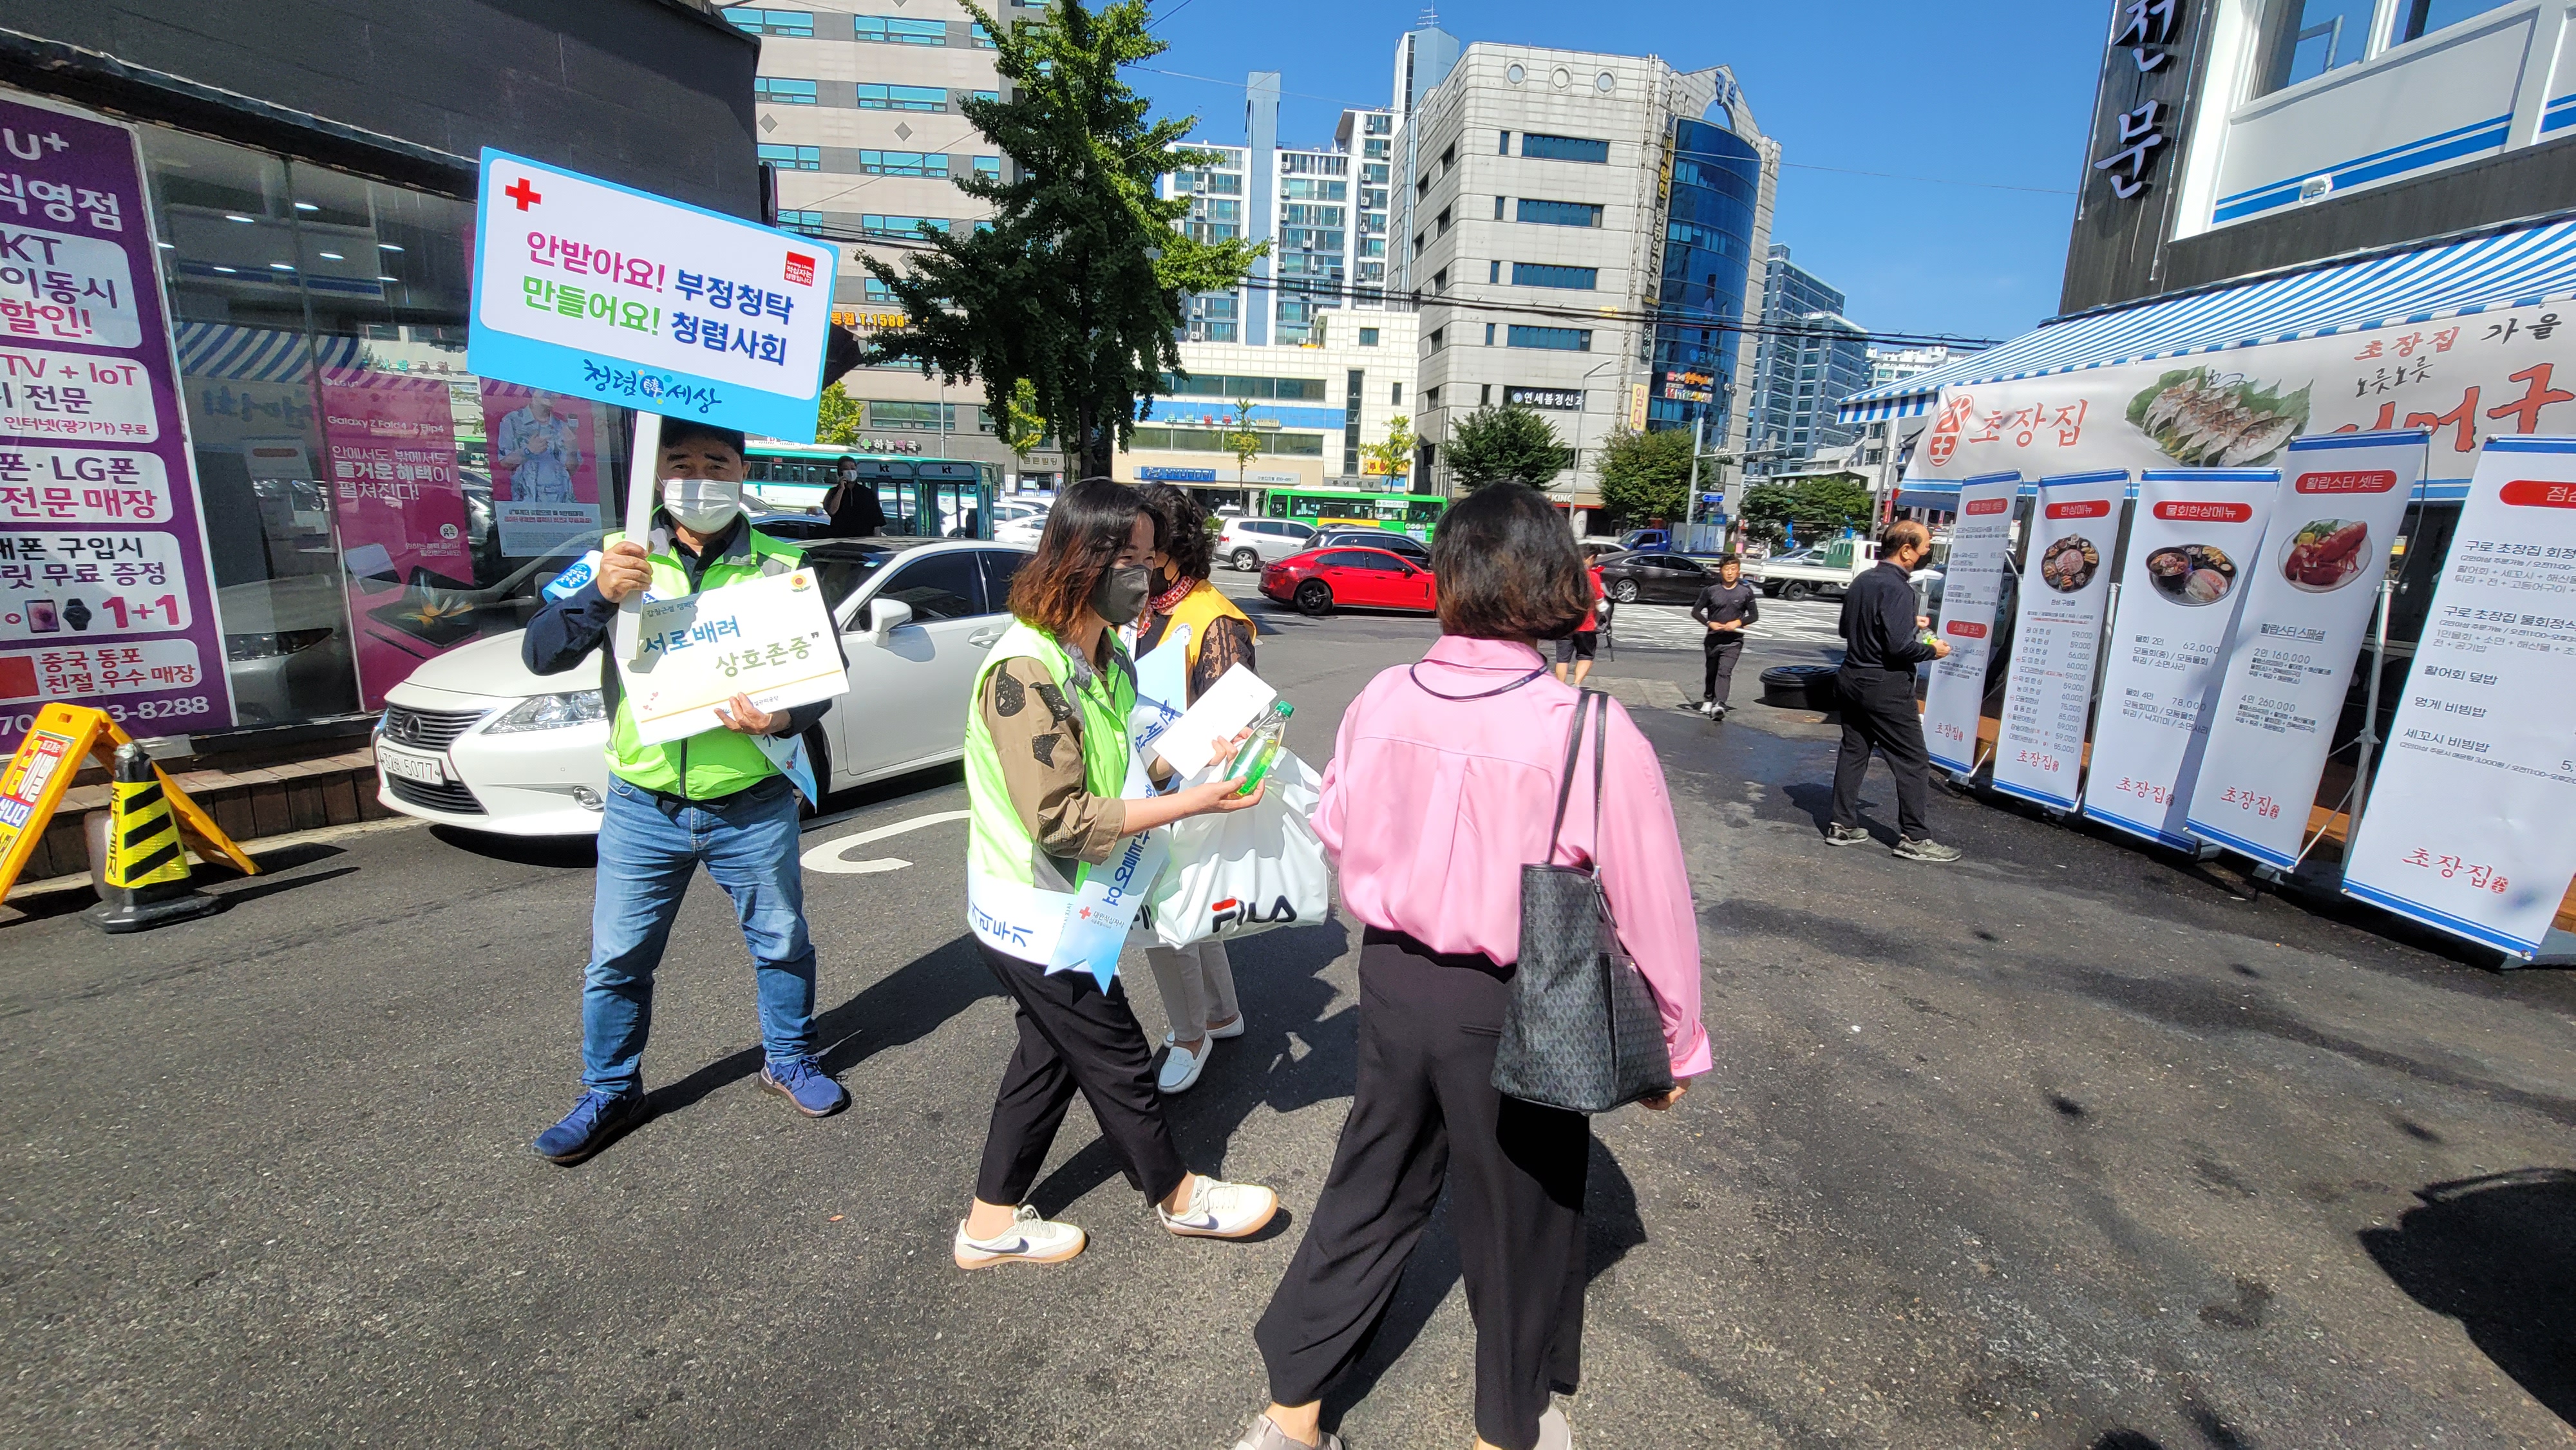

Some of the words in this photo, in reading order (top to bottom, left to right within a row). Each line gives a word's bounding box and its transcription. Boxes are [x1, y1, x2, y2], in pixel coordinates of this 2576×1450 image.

[3, 128, 70, 160] U+
[0, 173, 122, 231] 직영점
[0, 267, 117, 308] 이동시
[527, 232, 665, 294] 안받아요!
[674, 268, 794, 325] 부정청탁
[0, 298, 92, 338] 할인!
[523, 275, 660, 337] 만들어요!
[671, 311, 788, 366] 청렴사회
[831, 312, 855, 326] 병원
[2481, 313, 2562, 344] 가을
[2354, 326, 2460, 361] 초장집
[89, 362, 137, 386] IoT
[2356, 355, 2434, 398] 노릇노릇
[23, 384, 92, 414] 전문
[667, 384, 722, 413] 세상
[4, 417, 116, 435] 인터넷(광기가)
[120, 423, 149, 435] 무료
[327, 416, 367, 428] Galaxy
[1968, 399, 2088, 447] 초장집
[395, 449, 448, 464] 밖에서도
[873, 439, 917, 451] 하늘약국
[51, 456, 140, 484] LG폰
[336, 461, 393, 480] 즐거운
[396, 463, 450, 482] 혜택이
[942, 466, 952, 474] kt
[2306, 477, 2355, 489] 활랍스터
[2358, 475, 2384, 488] 셋트
[0, 487, 79, 517] 전문
[82, 489, 157, 518] 매장
[338, 482, 419, 500] 펼쳐진다!
[2061, 505, 2092, 515] 한상메뉴
[2166, 505, 2236, 518] 물회한상메뉴
[57, 538, 143, 559] 구입시
[2465, 540, 2494, 551] 구로
[2497, 543, 2541, 556] 초장집
[42, 564, 104, 587] 무료
[111, 562, 166, 586] 증정
[2510, 580, 2566, 593] 고등어구이
[102, 594, 180, 628] 1+1
[2444, 606, 2472, 617] 구로
[2474, 609, 2517, 623] 초장집
[40, 652, 90, 673] 중국
[96, 648, 144, 668] 동포
[45, 673, 95, 694] 친절
[100, 669, 147, 688] 우수
[151, 664, 195, 684] 매장
[2424, 665, 2465, 681] 활어회
[2470, 672, 2499, 685] 덮밥
[2414, 697, 2441, 711] 멍게
[2445, 702, 2488, 718] 비빔밥
[1935, 722, 1959, 741] 초장집
[2403, 728, 2445, 744] 세꼬시
[2447, 736, 2490, 753] 비빔밥
[404, 759, 433, 780] 5077
[2016, 750, 2052, 771] 초장집
[2116, 777, 2166, 804] 초장집
[2221, 787, 2271, 816] 초장집
[2401, 847, 2493, 889] 초장집
[1094, 911, 1124, 928] 대한적십자사
[1212, 896, 1297, 933] FILA
